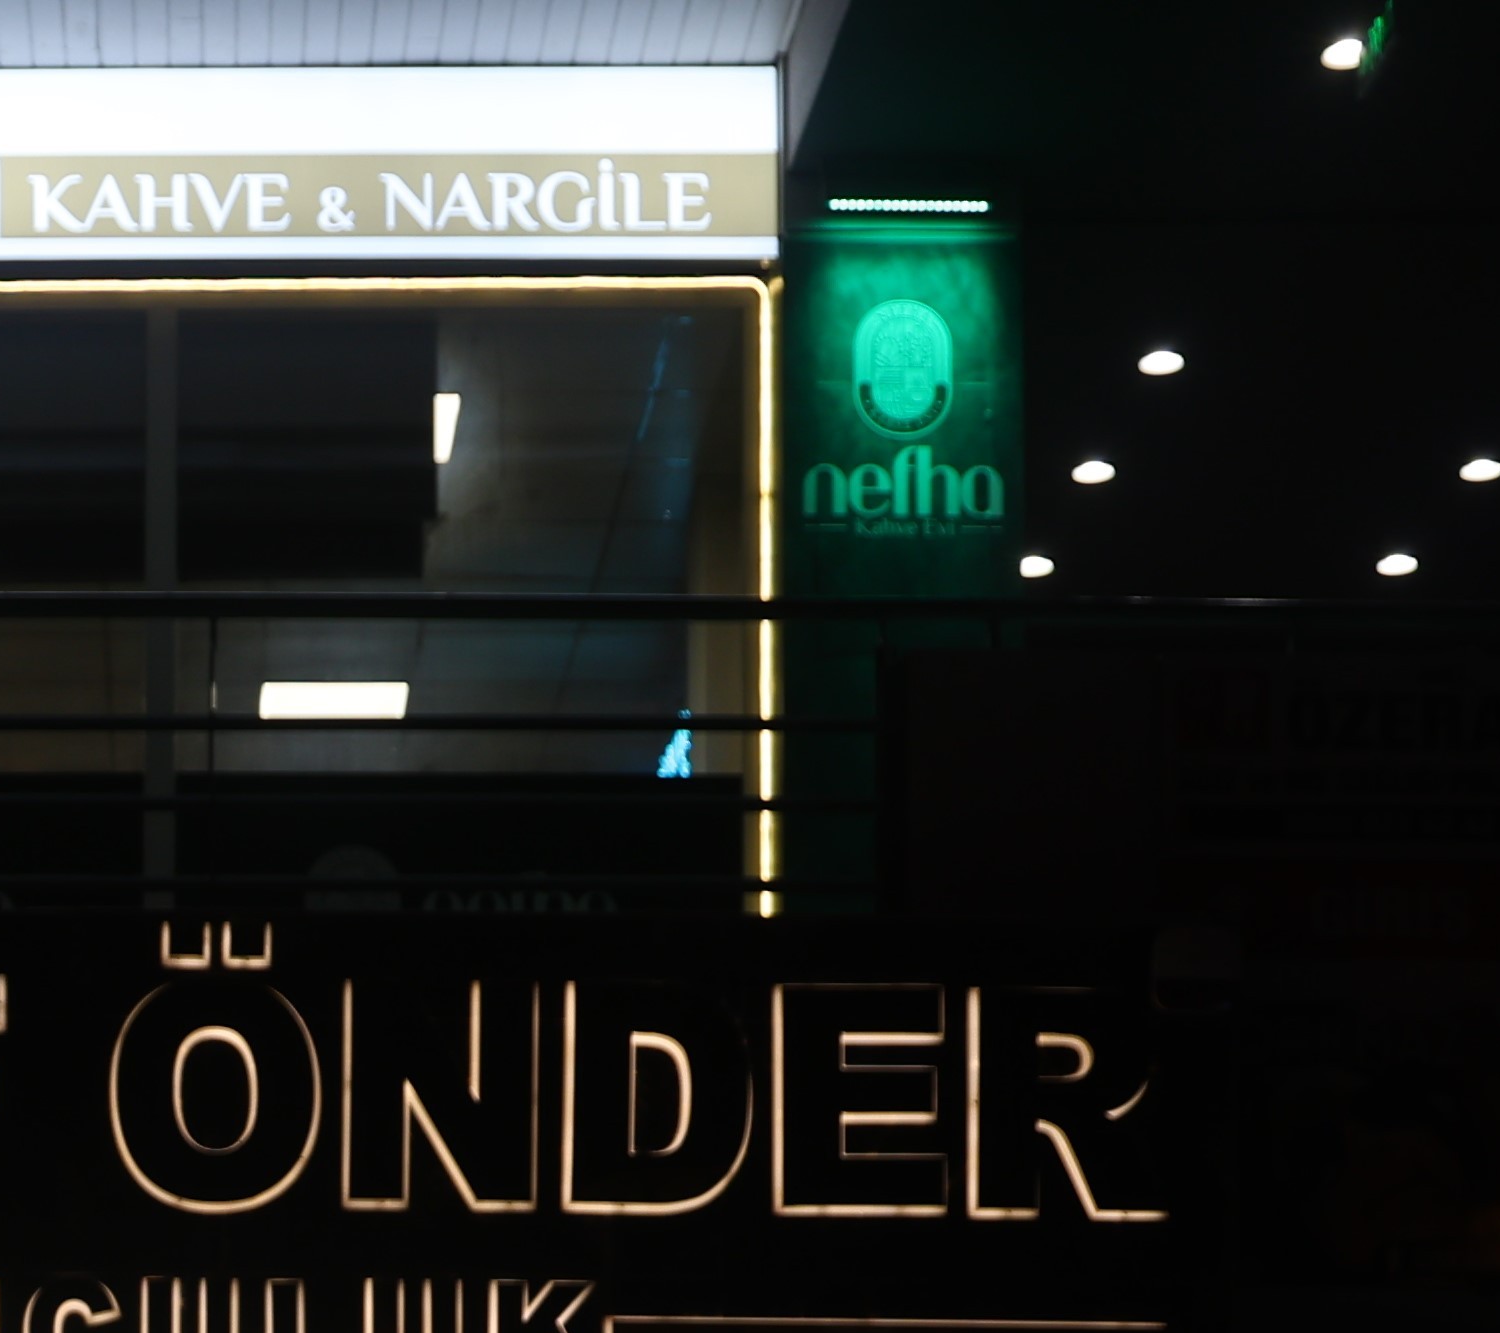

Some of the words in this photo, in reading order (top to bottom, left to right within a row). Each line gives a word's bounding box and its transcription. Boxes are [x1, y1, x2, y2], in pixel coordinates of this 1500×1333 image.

[26, 172, 290, 233] KAHVE
[316, 186, 355, 232] &
[378, 157, 712, 232] NARGİLE
[803, 444, 1006, 518] nefha
[108, 920, 1168, 1223] ÖNDER
